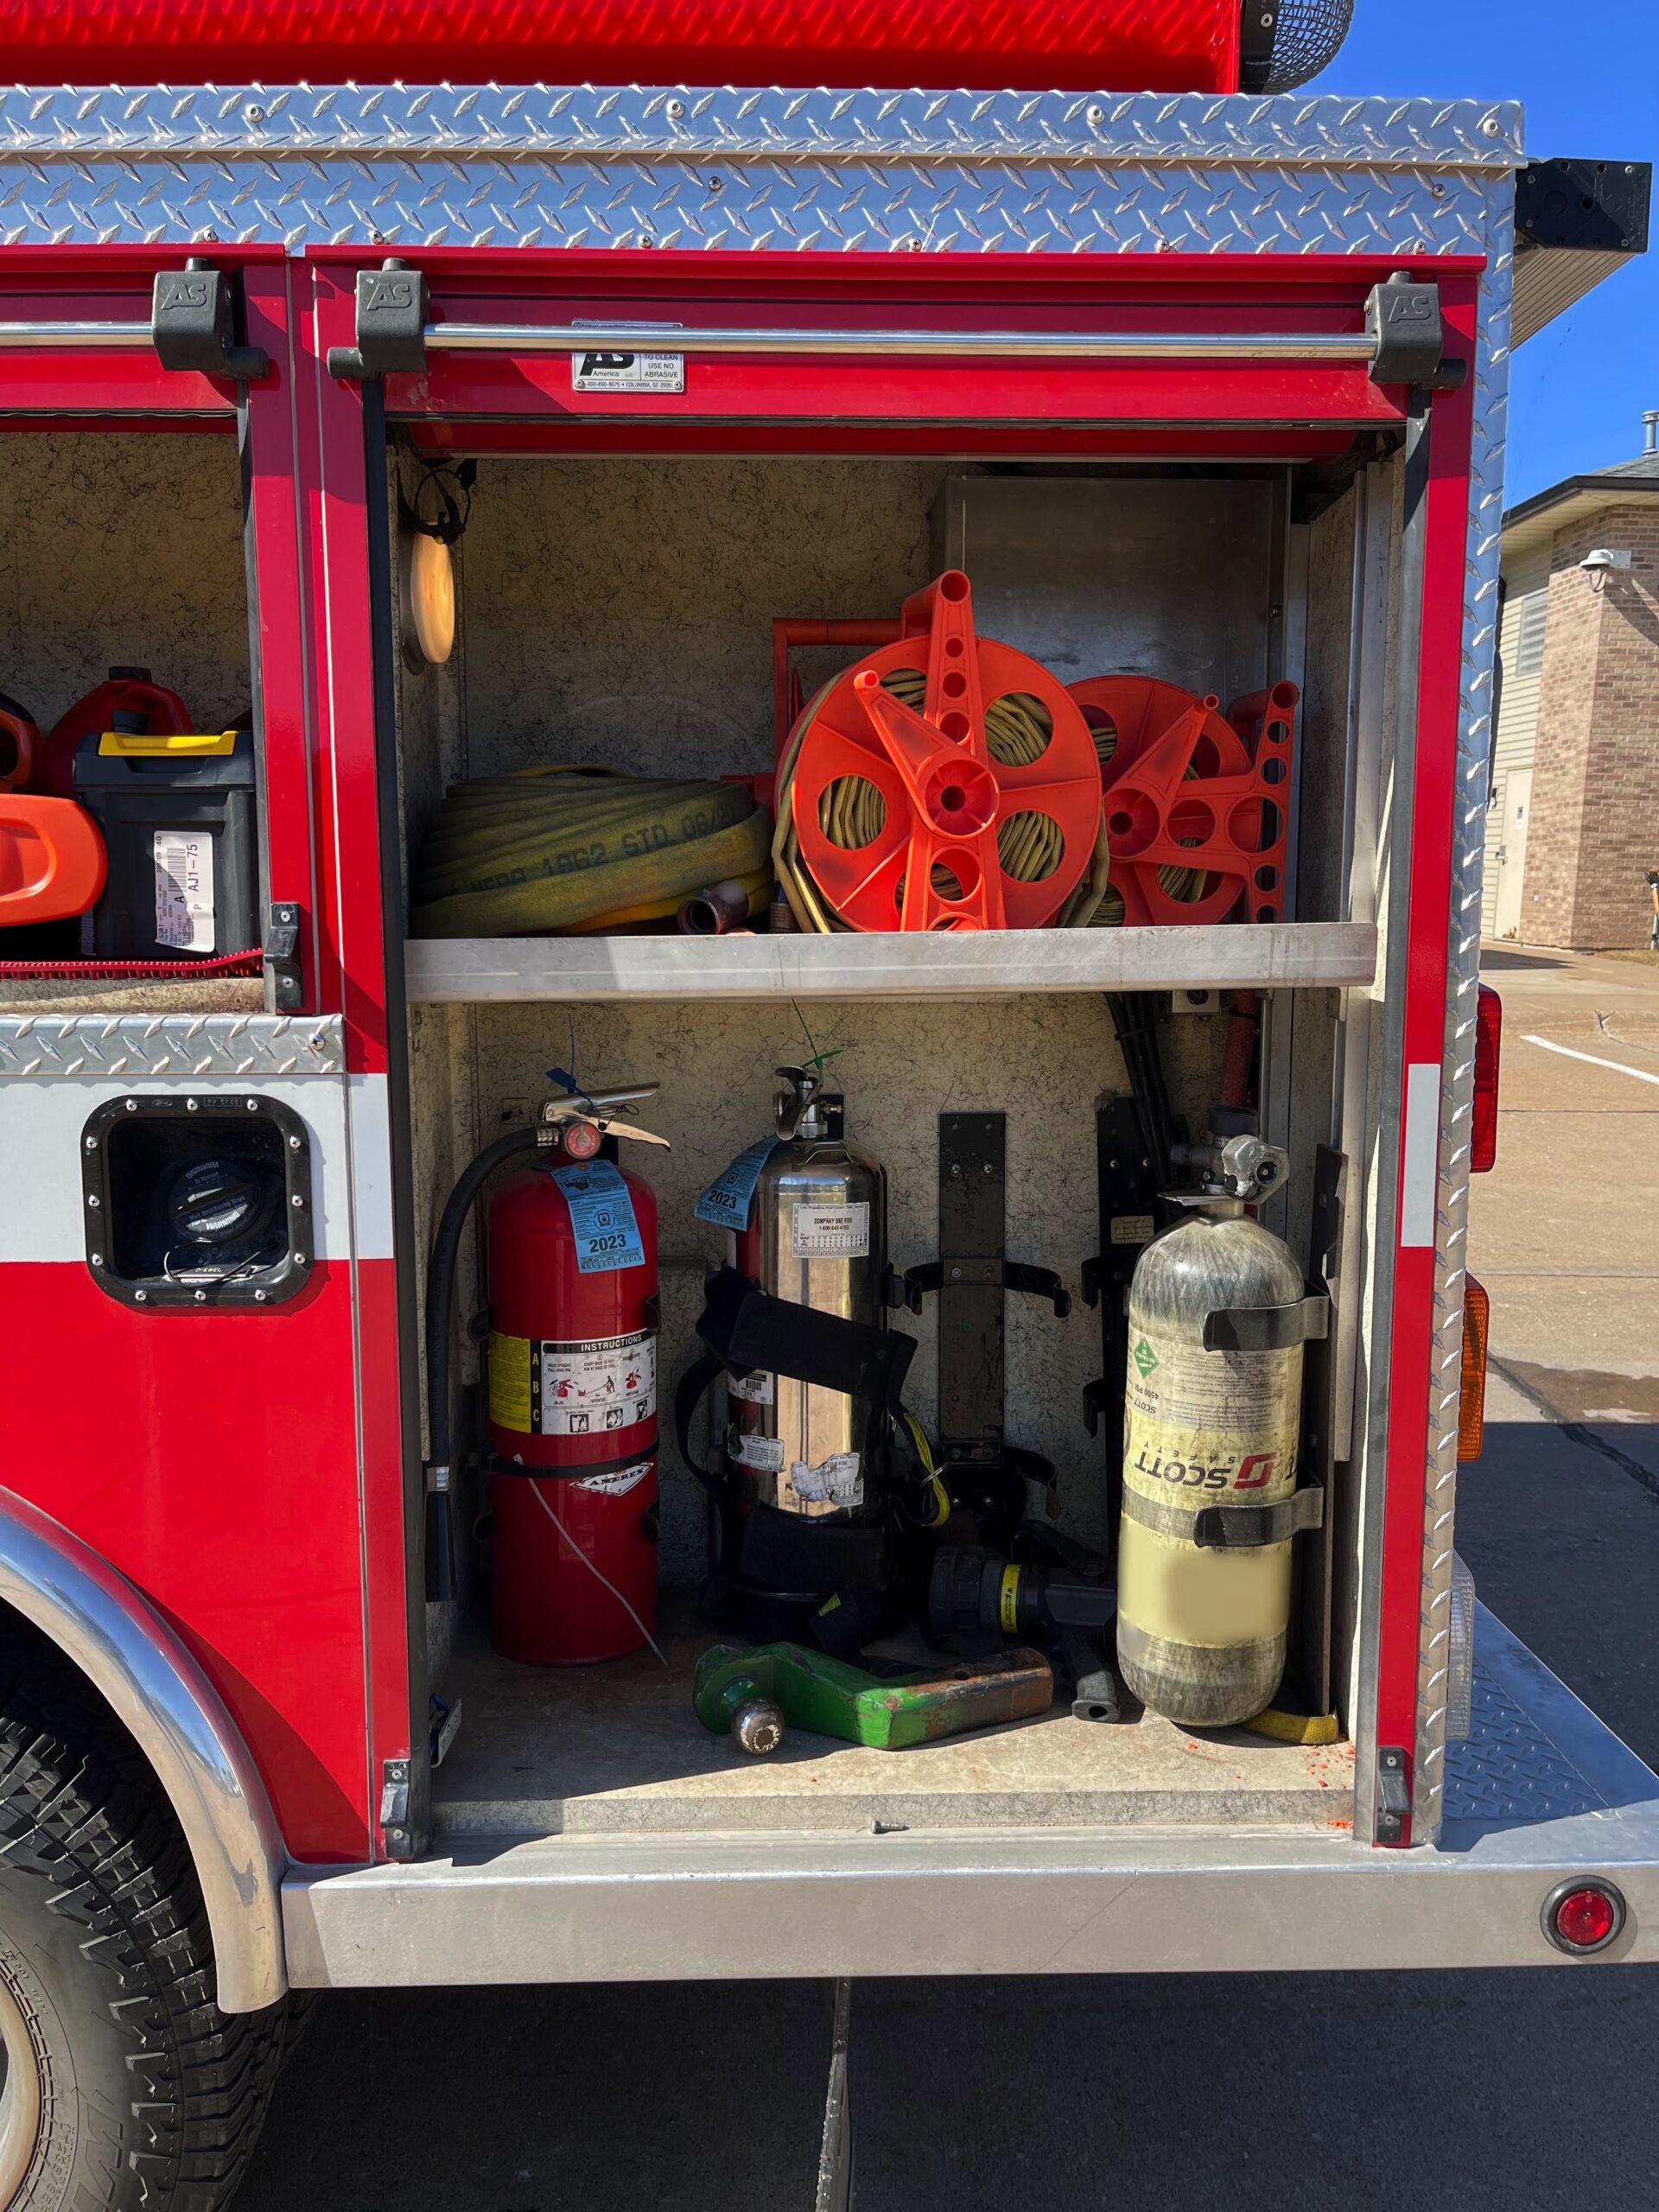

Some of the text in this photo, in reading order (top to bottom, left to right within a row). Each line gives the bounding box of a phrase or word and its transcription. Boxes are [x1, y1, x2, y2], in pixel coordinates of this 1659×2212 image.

[162, 283, 207, 309] AS
[366, 283, 412, 310] AS
[1389, 296, 1431, 323] AS
[622, 824, 669, 855] STD
[708, 1189, 737, 1210] 2023
[206, 1211, 240, 1230] WARNING
[589, 1234, 626, 1254] 2023
[581, 1335, 642, 1353] INSTRUCTIONS
[532, 1353, 538, 1365] A
[533, 1381, 539, 1393] B
[1135, 1383, 1159, 1400] 4500 PSI
[533, 1408, 539, 1421] C
[1134, 1399, 1157, 1414] SCOTT
[1143, 1440, 1236, 1465] SAFETY
[589, 1467, 645, 1486] AMEREX
[1135, 1451, 1231, 1489] SCOTT
